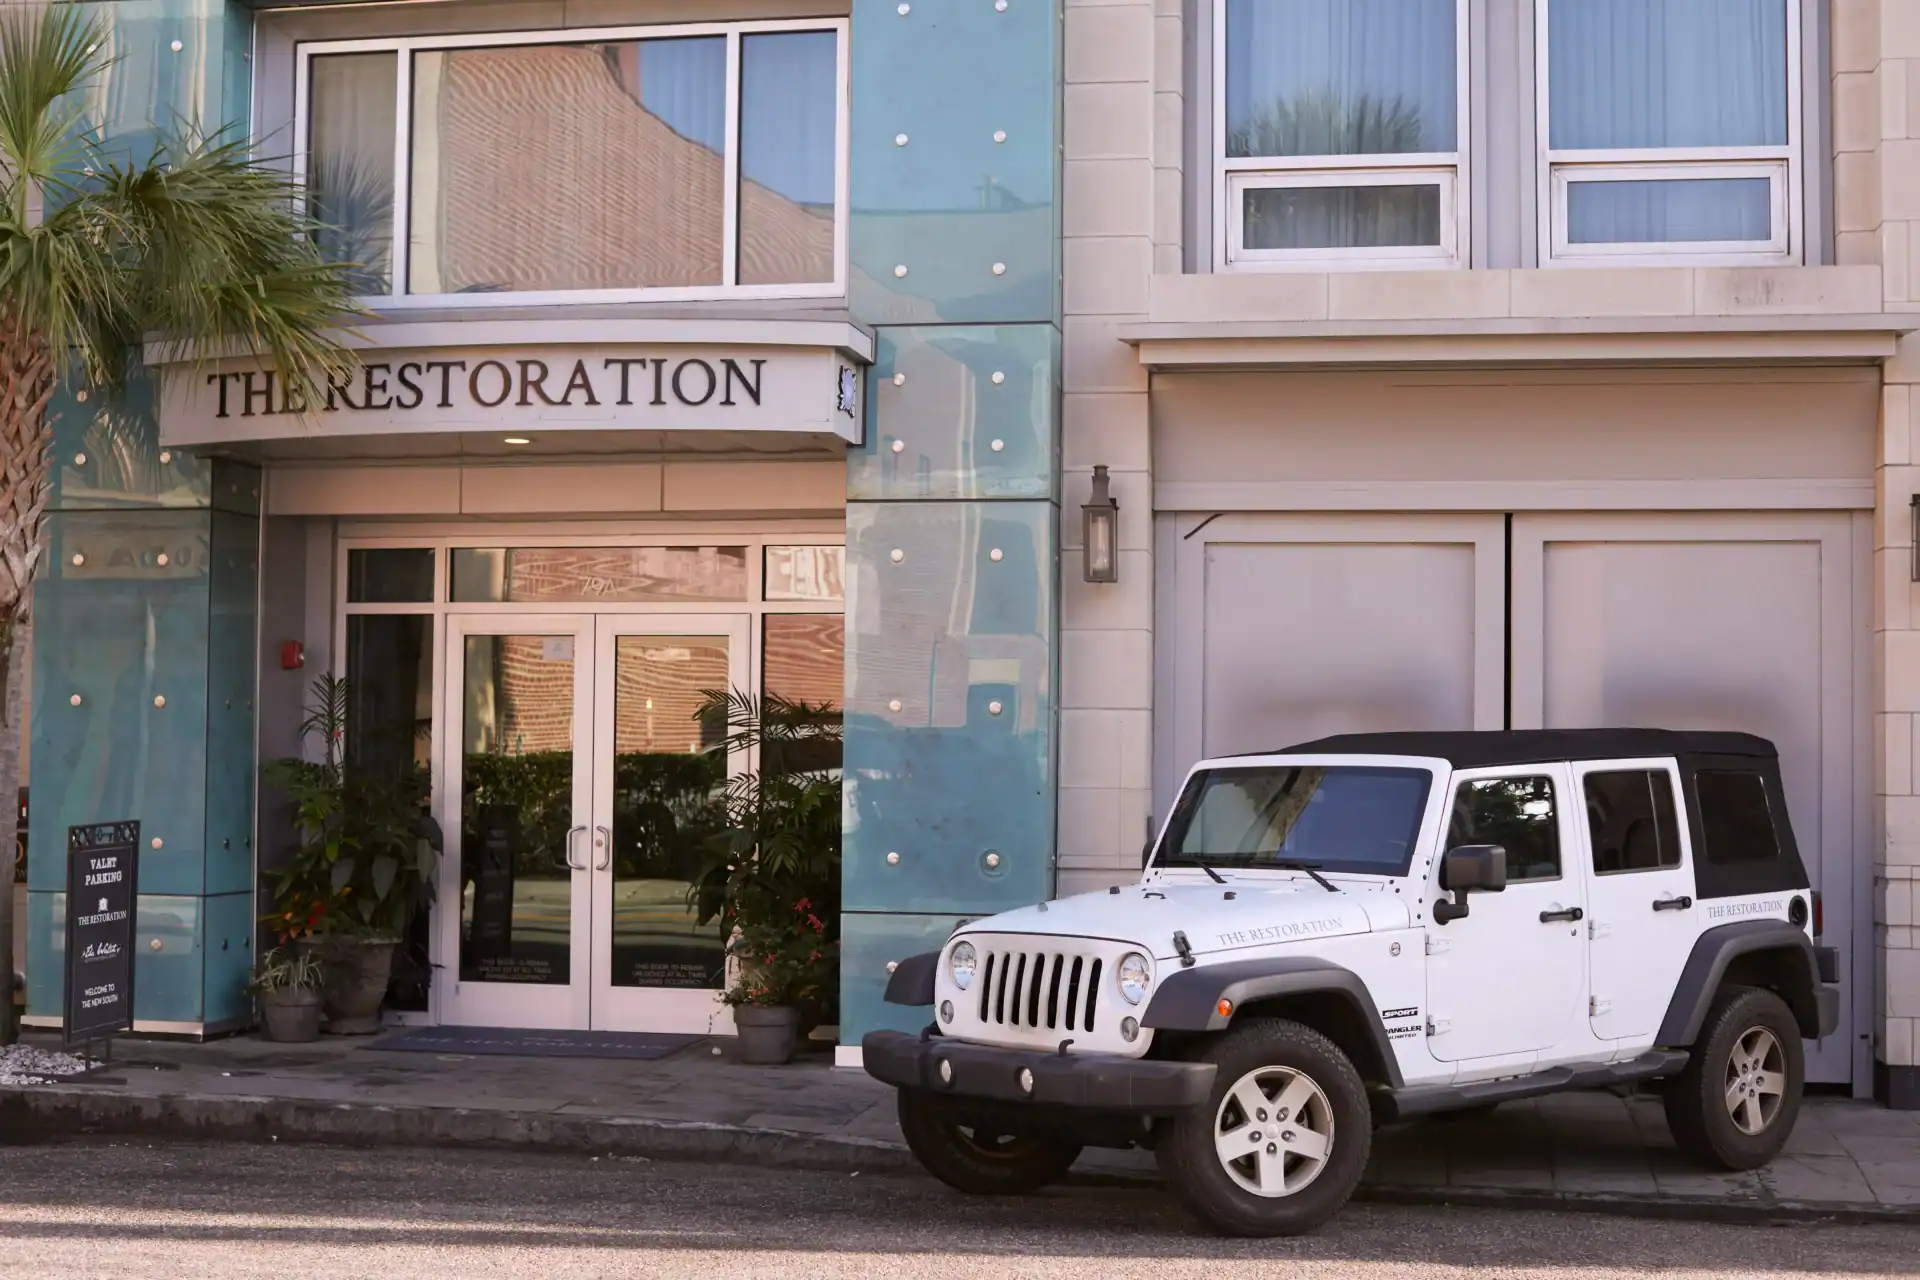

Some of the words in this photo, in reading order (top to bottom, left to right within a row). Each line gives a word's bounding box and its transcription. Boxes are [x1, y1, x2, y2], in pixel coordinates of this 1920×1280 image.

[207, 366, 307, 418] THE
[322, 357, 767, 412] RESTORATION
[90, 857, 117, 870] VALET
[85, 871, 122, 886] PARKING
[1707, 905, 1725, 918] THE
[1726, 900, 1784, 916] RESTORATION
[78, 916, 90, 926] THE
[90, 910, 127, 924] RESTORATION
[1216, 931, 1247, 946] THE
[1248, 917, 1343, 942] RESTORATION
[84, 985, 108, 996] WELCOME
[108, 983, 115, 993] TO
[81, 1000, 91, 1009] THE
[91, 997, 102, 1007] NEW
[102, 994, 119, 1005] SOUTH
[1384, 1008, 1417, 1018] SPORT
[1385, 1025, 1422, 1034] ANGLER
